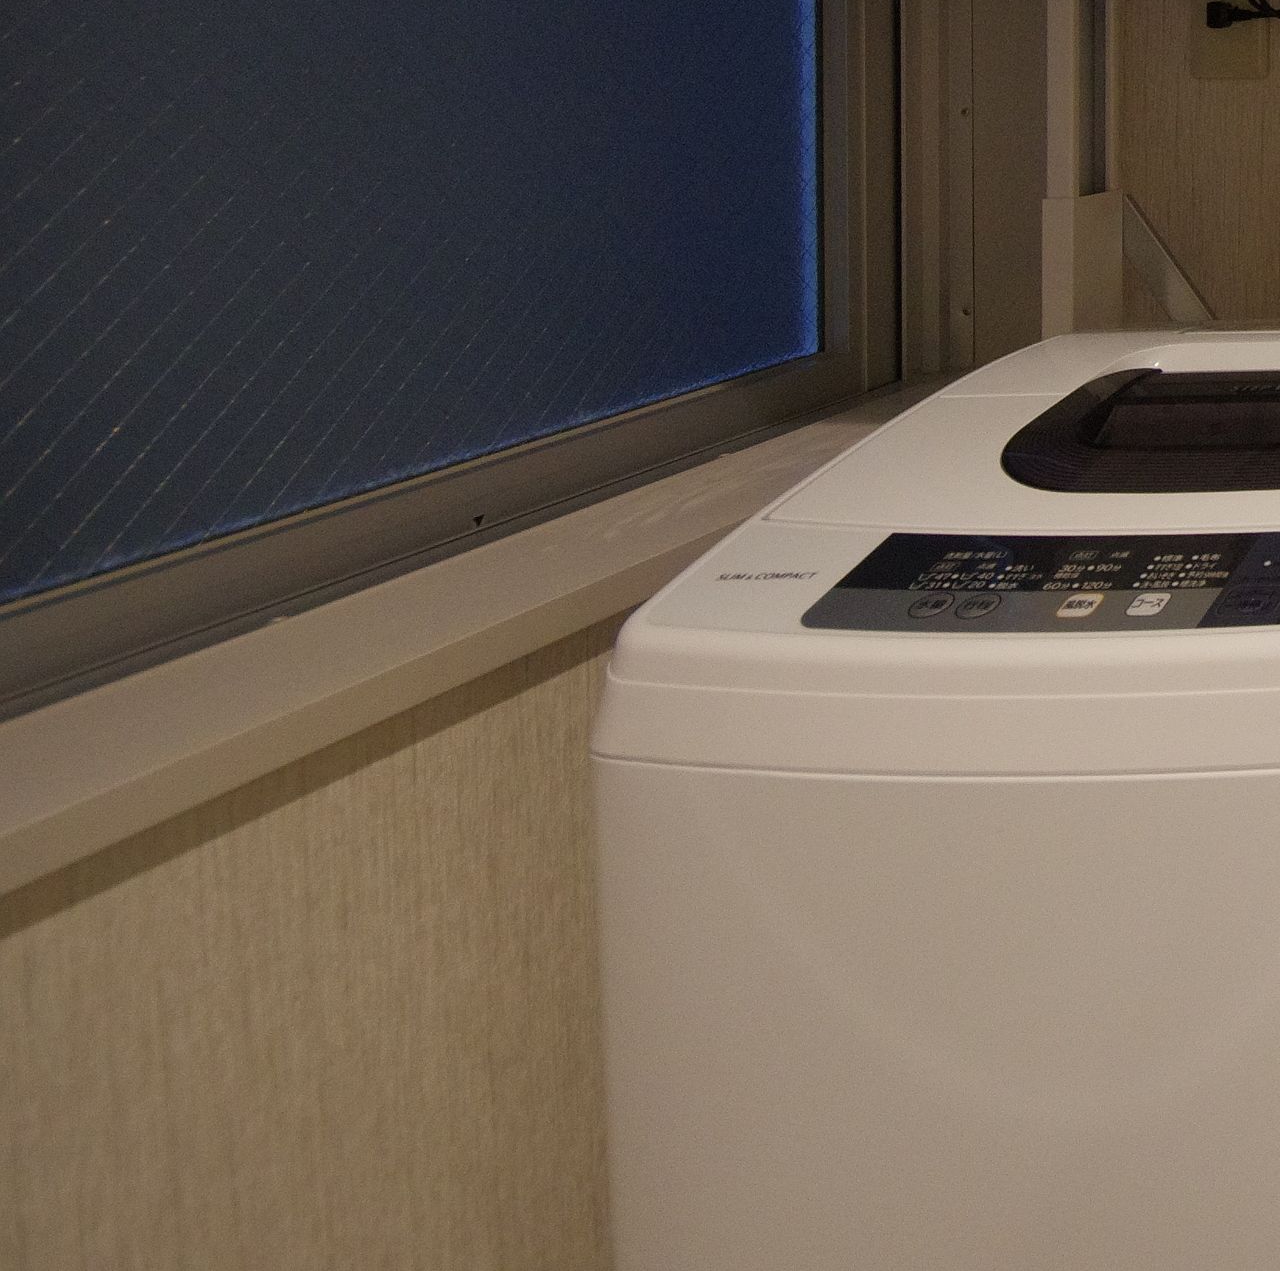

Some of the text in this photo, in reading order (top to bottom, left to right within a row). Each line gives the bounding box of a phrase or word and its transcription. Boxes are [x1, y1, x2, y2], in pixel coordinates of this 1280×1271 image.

[754, 572, 819, 581] COMPACT
[1131, 599, 1165, 609] コース
